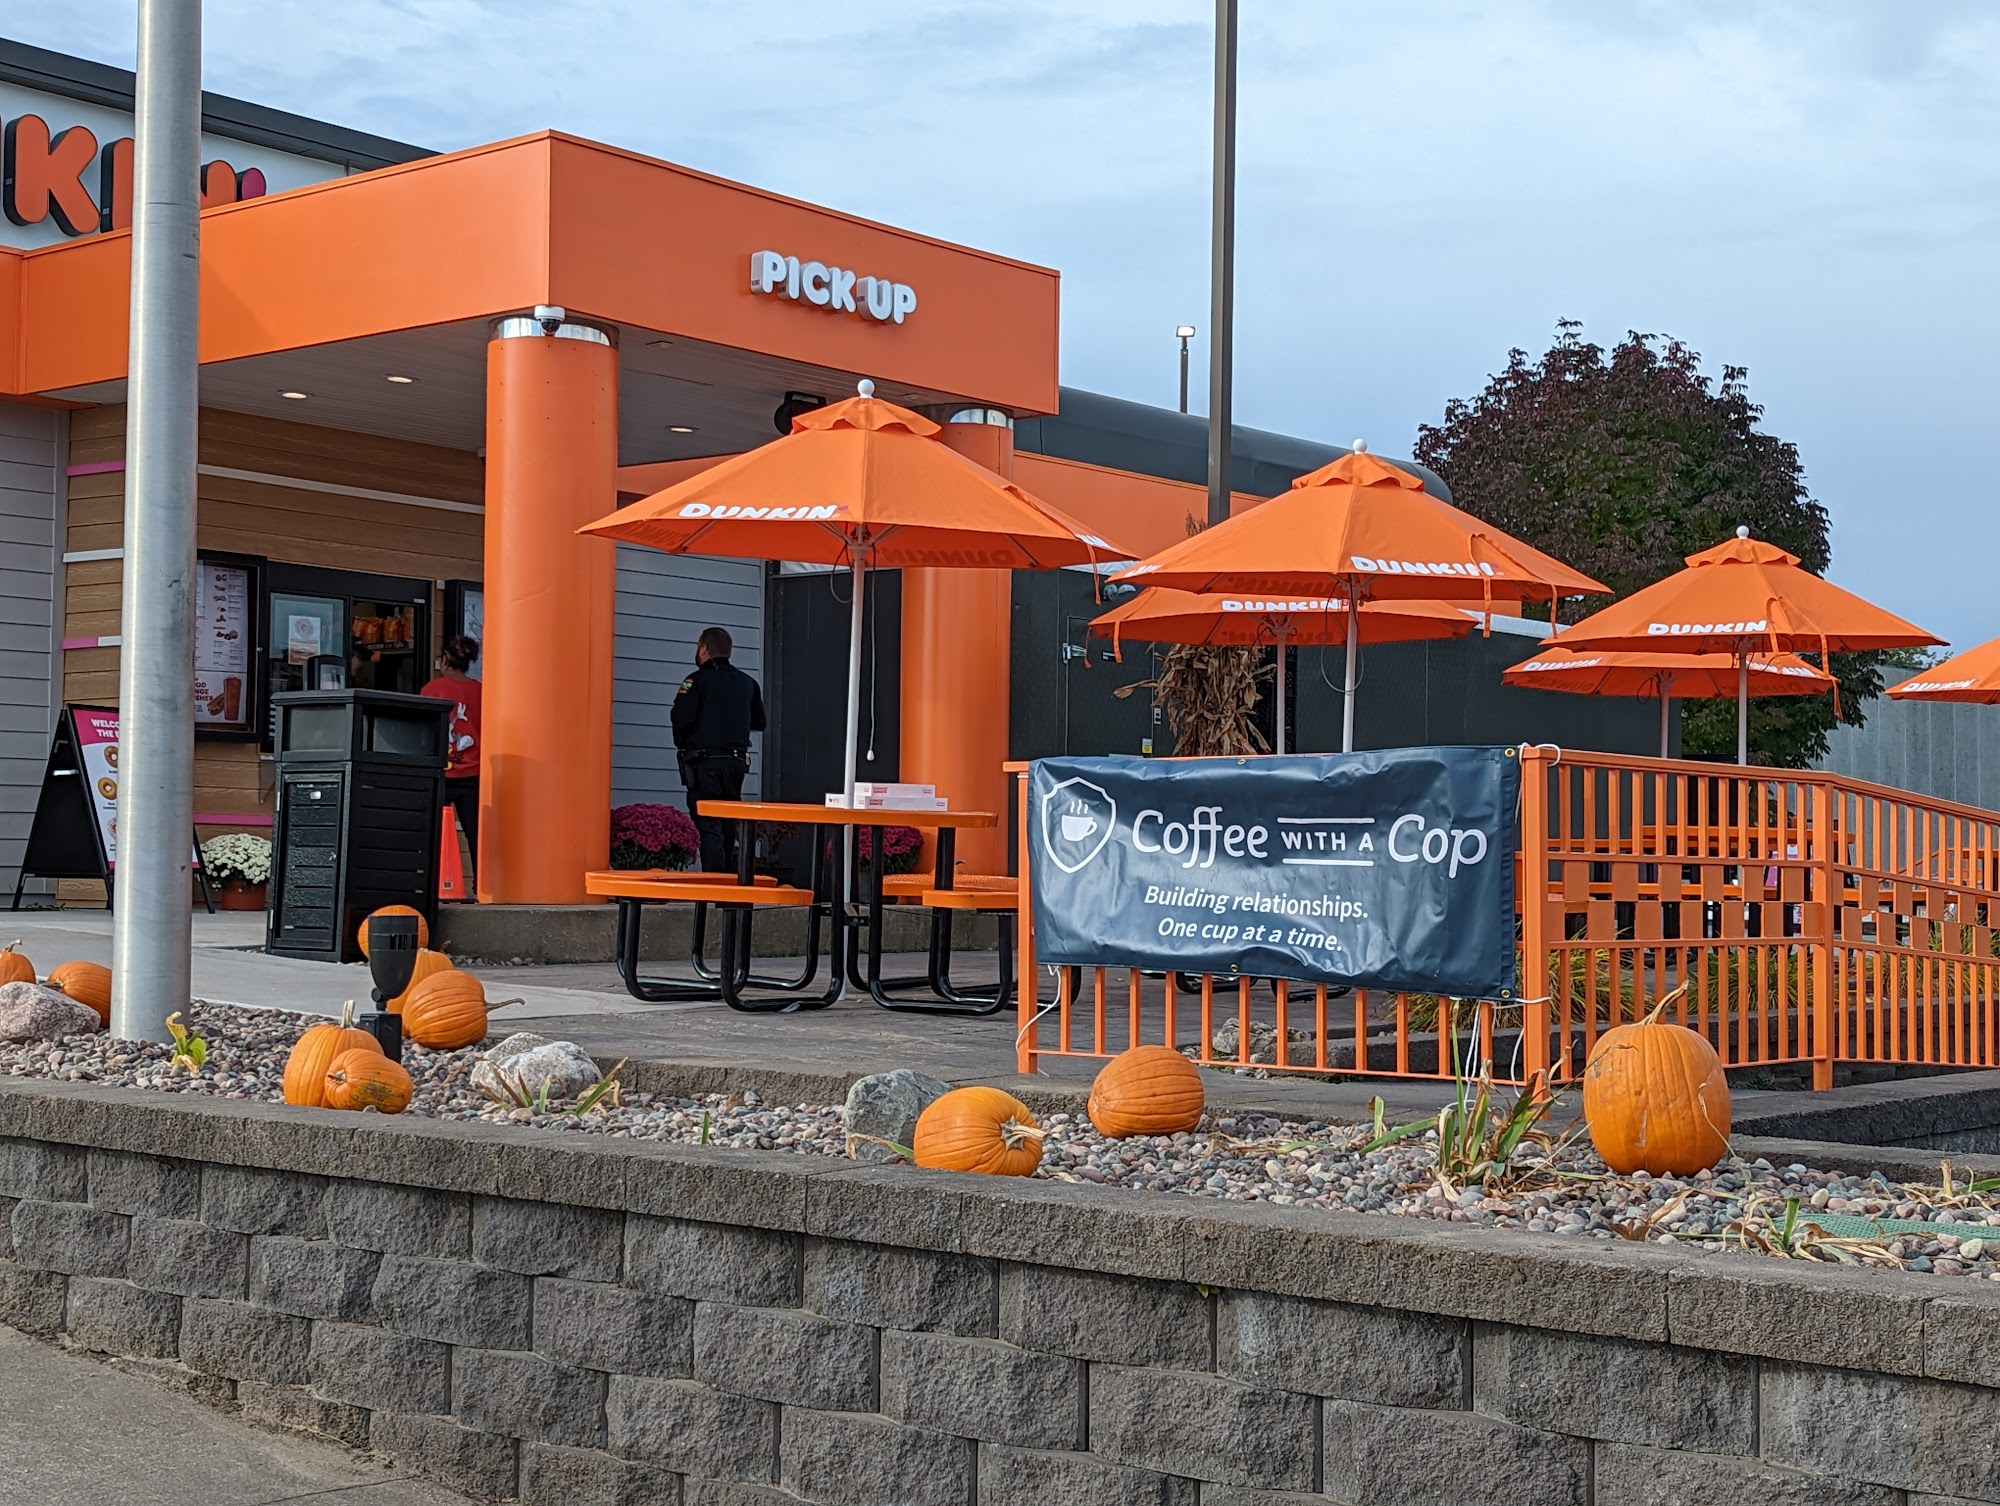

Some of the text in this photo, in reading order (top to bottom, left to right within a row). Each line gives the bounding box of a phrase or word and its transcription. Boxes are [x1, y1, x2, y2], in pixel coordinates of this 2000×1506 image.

[751, 250, 918, 324] PICK UP
[1132, 806, 1487, 878] Coffee WITH A Cop
[1144, 885, 1369, 922] Building relationships.
[1158, 917, 1342, 952] One cup at a time.
